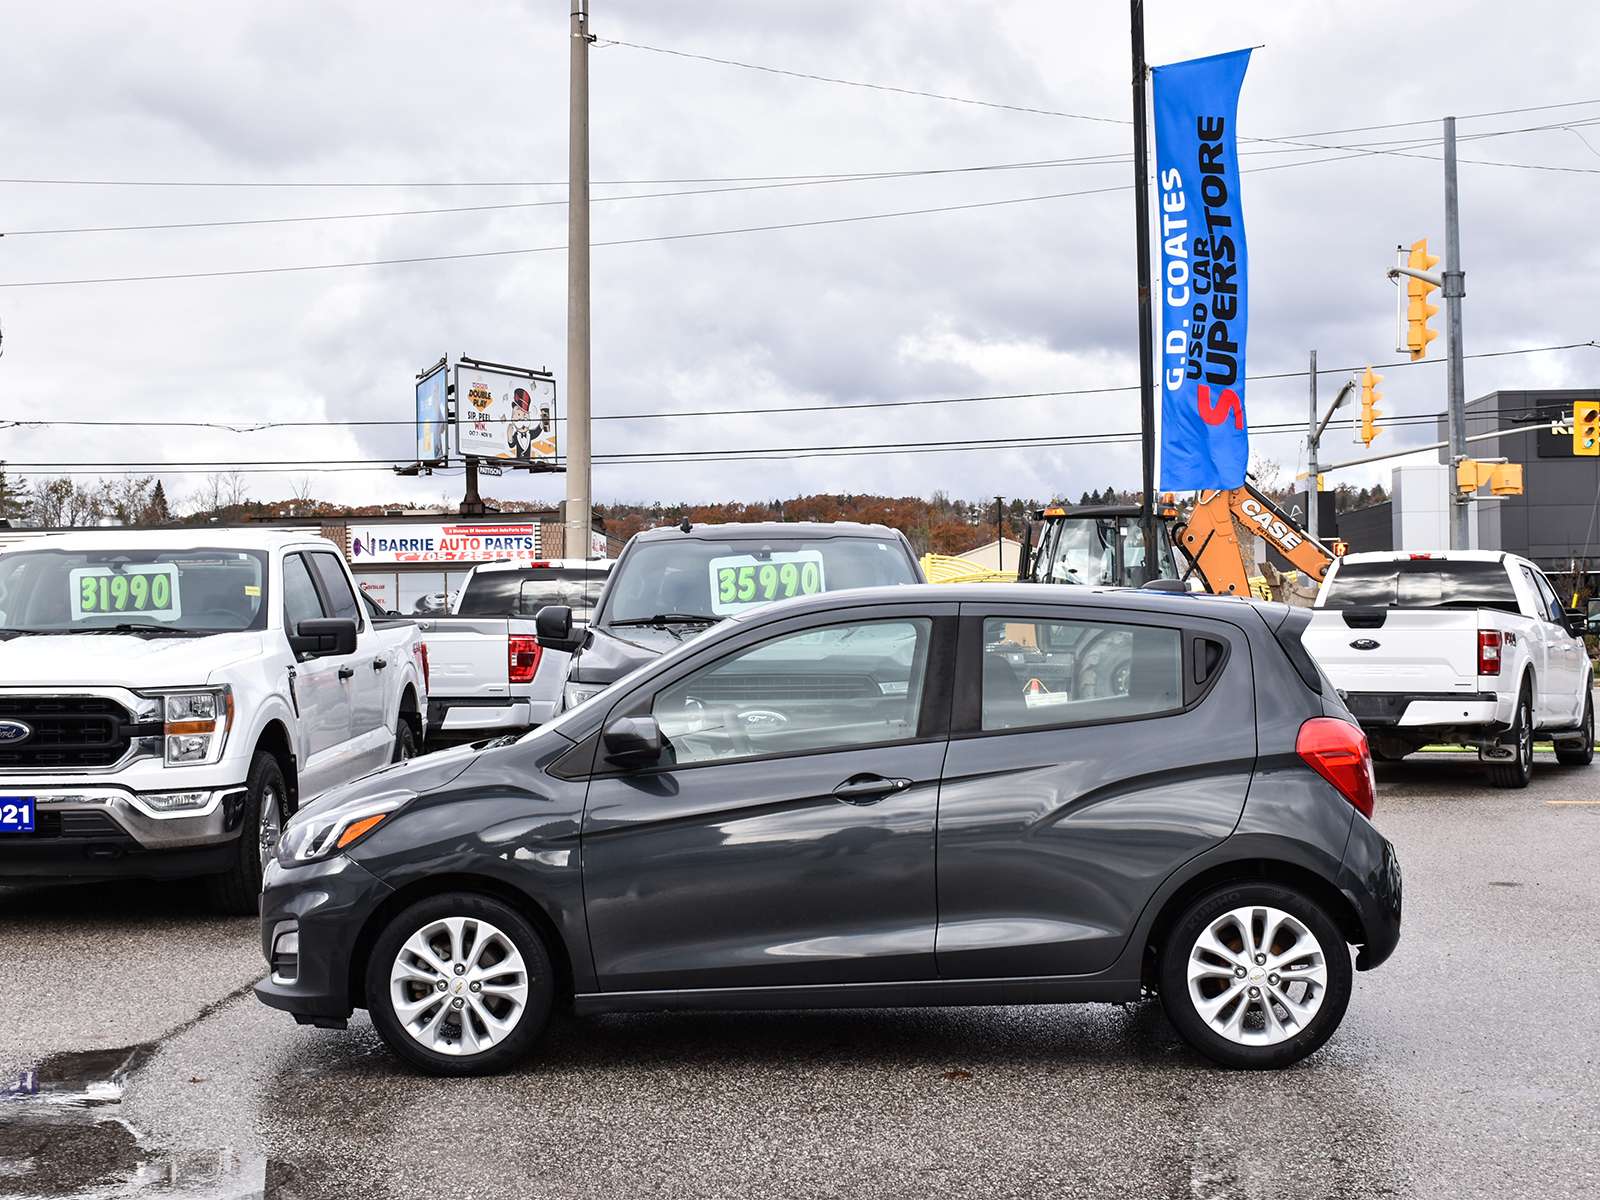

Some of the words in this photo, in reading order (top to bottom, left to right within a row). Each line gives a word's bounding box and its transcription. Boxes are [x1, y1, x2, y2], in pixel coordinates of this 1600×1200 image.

[1161, 168, 1190, 308] COATES
[1192, 237, 1211, 295] CAR
[1197, 116, 1243, 431] SUPERSTORE
[1165, 320, 1190, 392] G.D.
[1186, 303, 1208, 380] USED
[469, 389, 492, 400] DOUBLE
[472, 398, 488, 409] PLAY
[378, 538, 434, 552] BARRIE
[439, 537, 481, 551] AUTO
[485, 536, 533, 550] PARTS
[1241, 498, 1303, 551] CASE
[81, 574, 170, 611] 31990
[719, 562, 818, 602] 35990
[0, 804, 30, 824] 21
